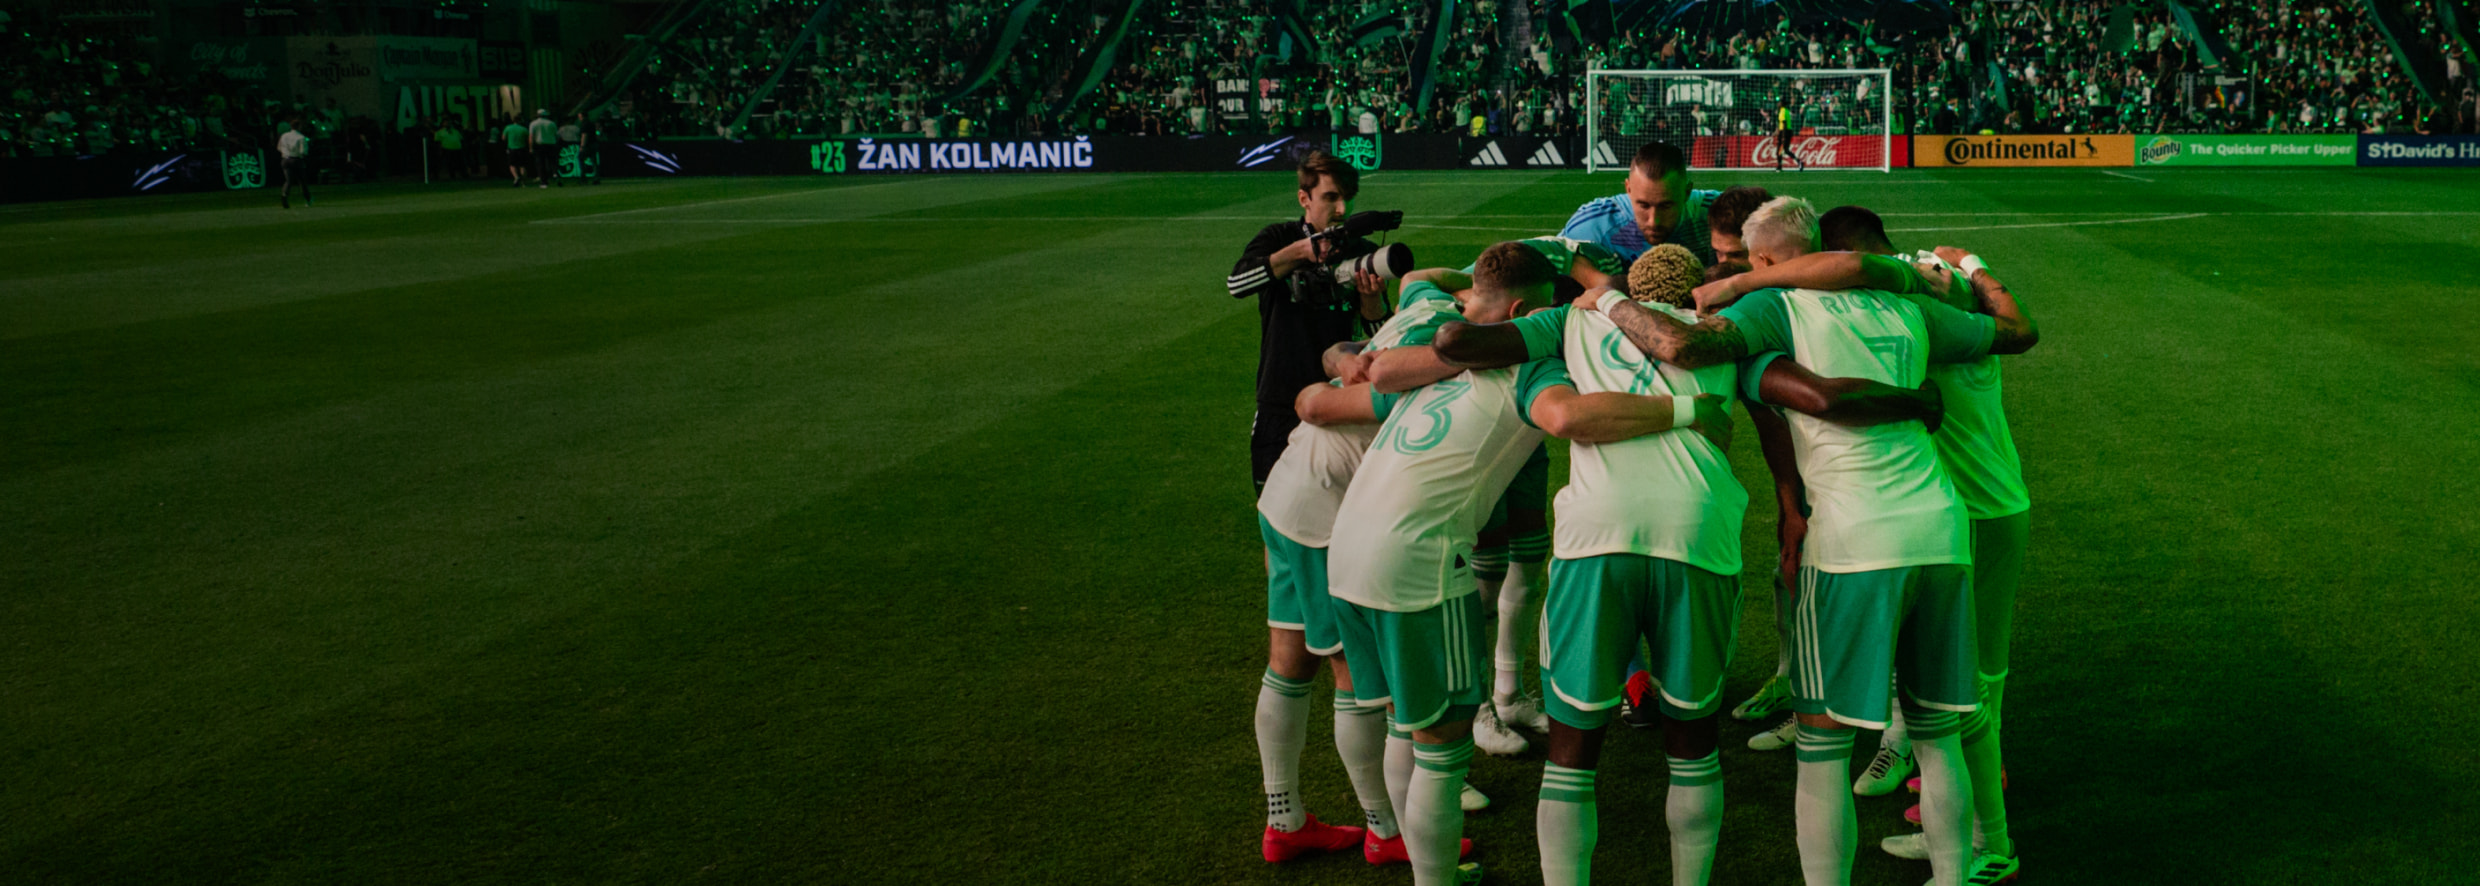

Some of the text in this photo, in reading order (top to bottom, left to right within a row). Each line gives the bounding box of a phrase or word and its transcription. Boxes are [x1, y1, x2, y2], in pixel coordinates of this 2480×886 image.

[810, 135, 1093, 173] #23 ŽAN KOLMANIČ
[1945, 138, 2077, 165] Continental
[2141, 141, 2182, 163] Bounty
[2190, 143, 2353, 156] The Quicker Picker Upper
[1372, 380, 1472, 455] 13
